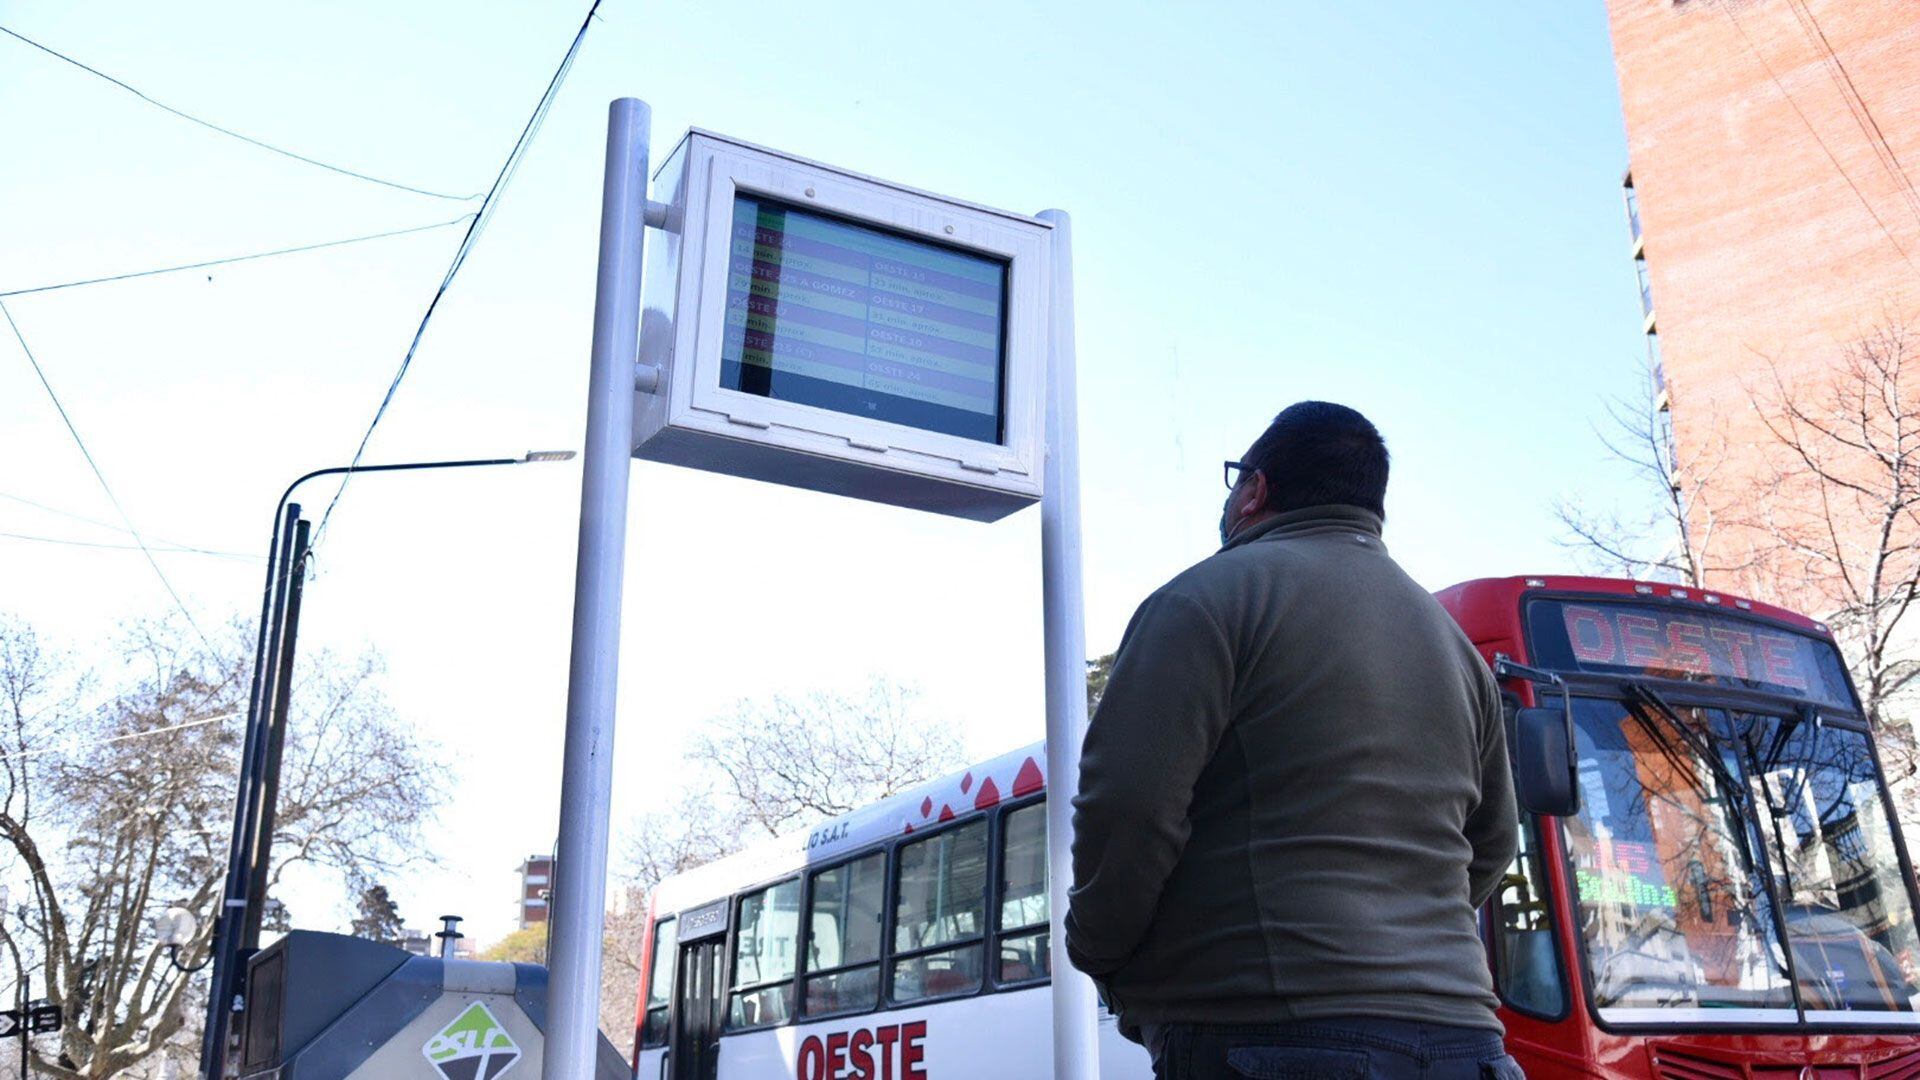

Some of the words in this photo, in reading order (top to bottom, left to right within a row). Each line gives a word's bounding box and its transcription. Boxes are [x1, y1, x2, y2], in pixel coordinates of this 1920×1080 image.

[873, 260, 910, 278] OESTE
[871, 293, 908, 311] OESTE
[869, 327, 906, 344] OESTE
[867, 361, 903, 378] OESTE
[1562, 604, 1808, 690] OESTE
[797, 1020, 928, 1080] OESTE
